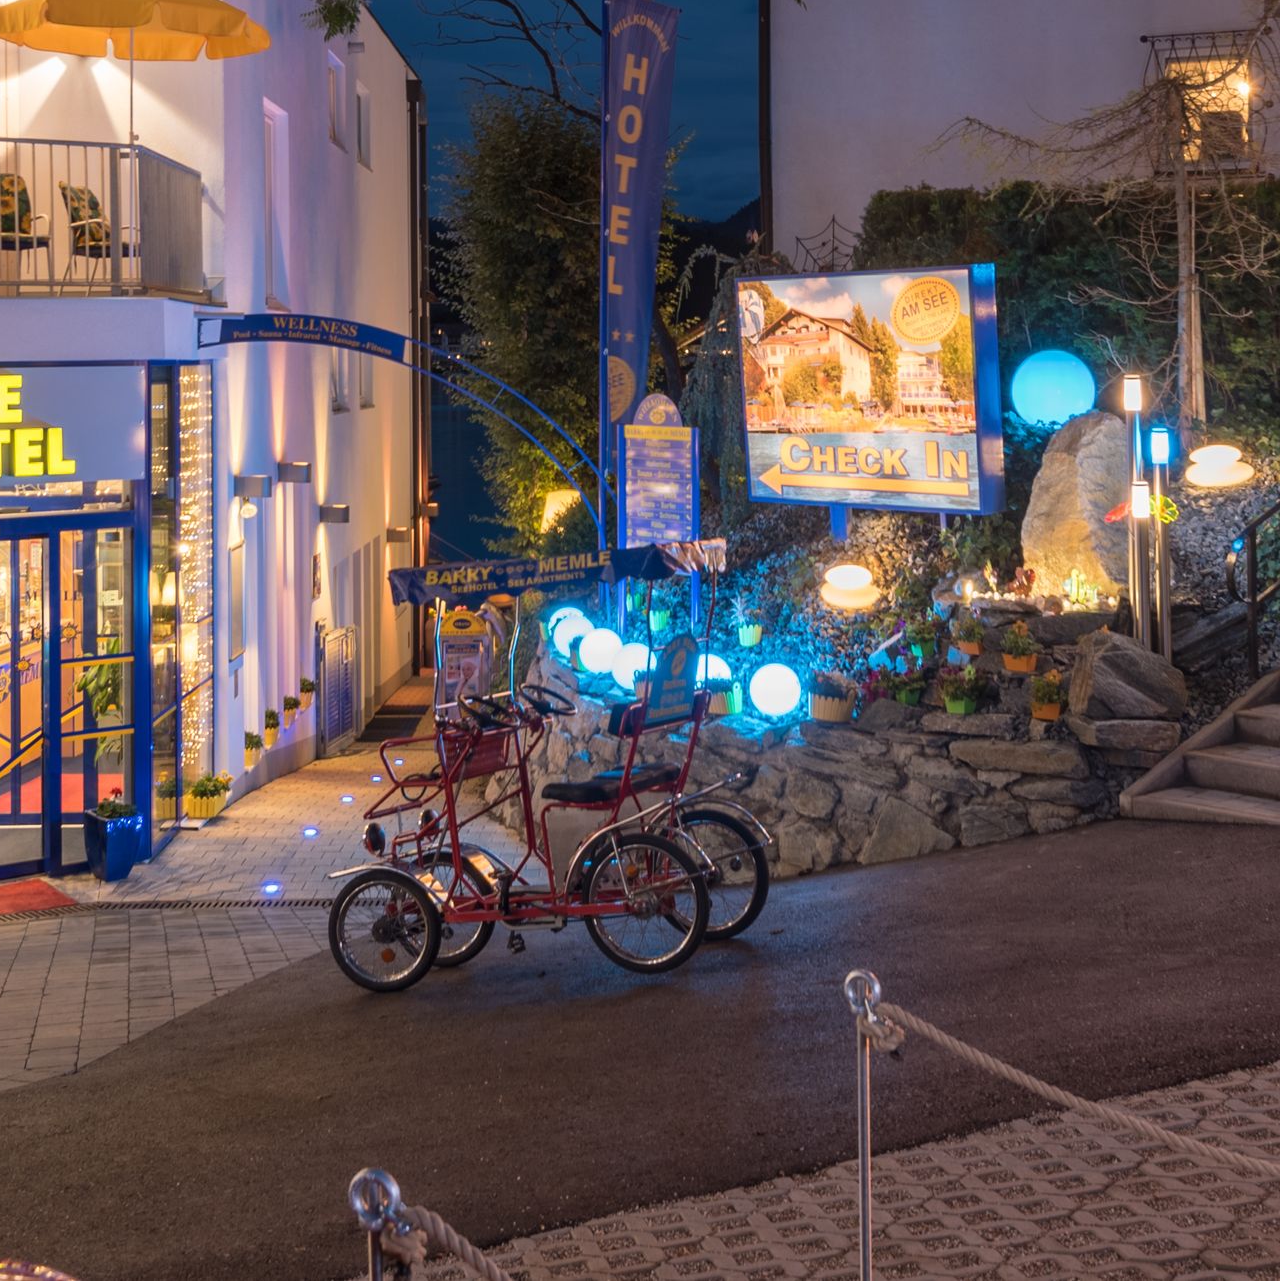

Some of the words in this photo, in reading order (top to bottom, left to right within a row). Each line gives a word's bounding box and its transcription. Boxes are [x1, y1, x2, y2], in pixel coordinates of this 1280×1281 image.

[611, 13, 671, 54] WILLKOMMEN
[607, 53, 649, 295] HOTEL
[901, 302, 921, 320] AM
[922, 290, 949, 311] SEE
[904, 285, 939, 304] DIREKT
[273, 317, 359, 338] WELLNESS
[258, 329, 282, 338] Sauna
[288, 330, 320, 340] Infrared
[328, 334, 361, 349] Massage
[366, 342, 392, 356] Fitness
[538, 550, 613, 574] MEMLE
